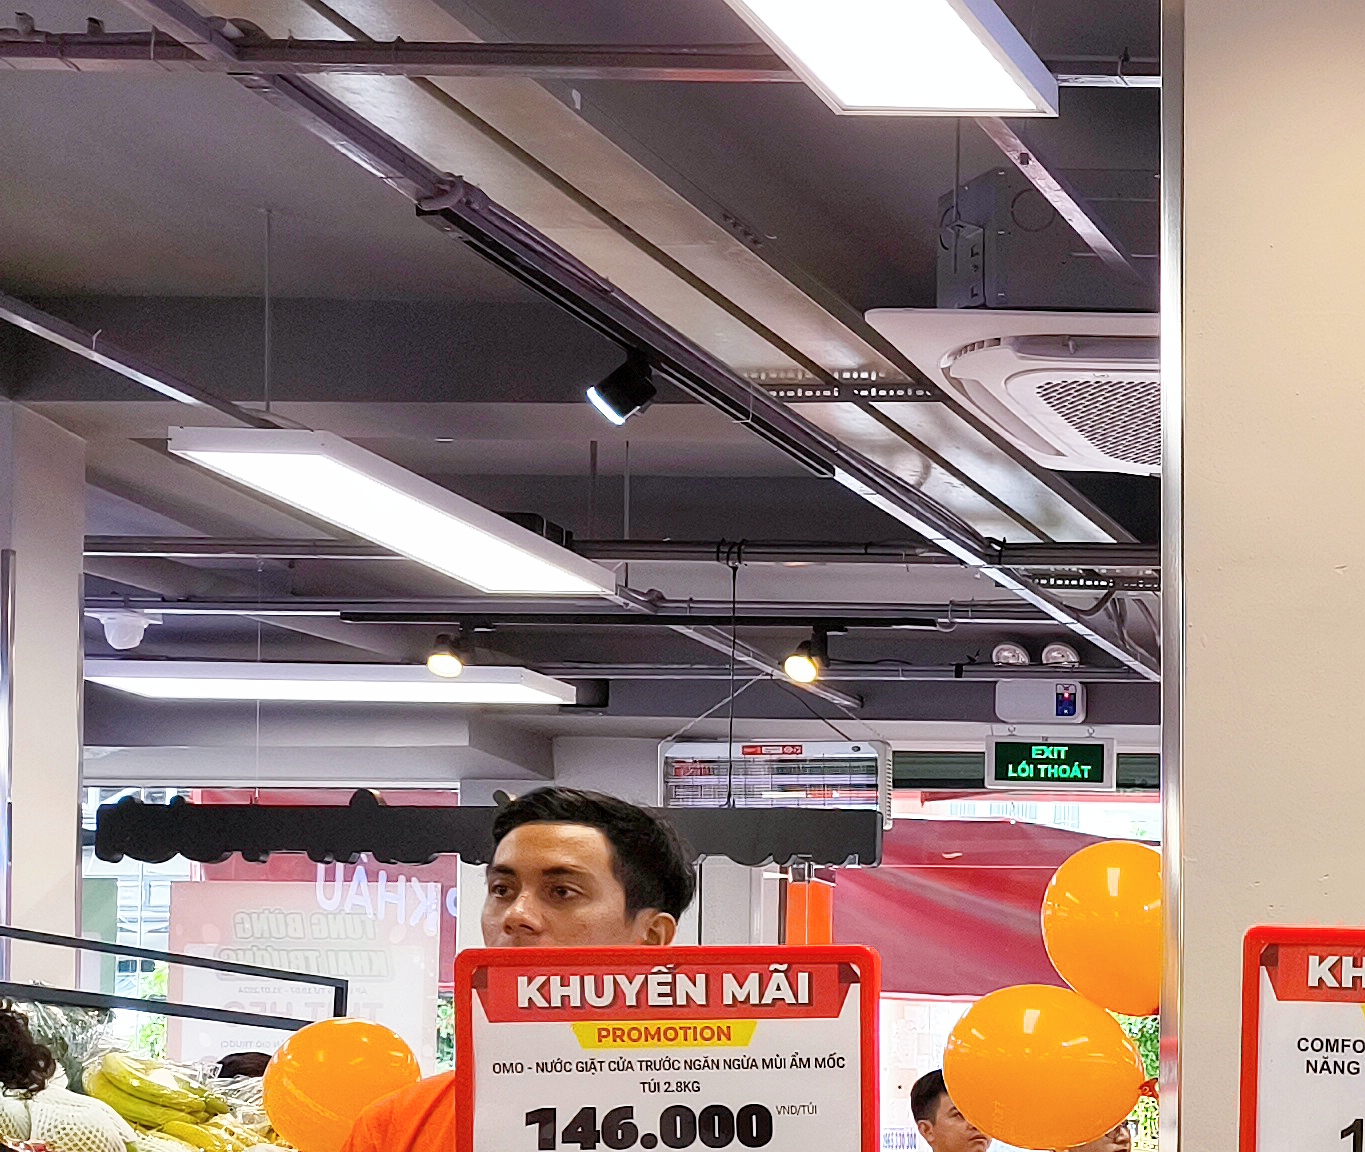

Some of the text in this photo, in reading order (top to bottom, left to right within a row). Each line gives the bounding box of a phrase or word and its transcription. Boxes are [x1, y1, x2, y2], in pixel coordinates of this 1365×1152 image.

[1032, 745, 1068, 761] EXIT
[1037, 761, 1092, 779] THOÁT
[517, 963, 810, 1008] KHUYẾN MÃI
[597, 1025, 732, 1044] PROMOTION
[492, 1062, 523, 1075] OMO
[535, 1056, 572, 1074] NƯỚC
[575, 1058, 605, 1077] GIẶT
[608, 1055, 634, 1073] CỬA
[638, 1055, 681, 1072] TRƯỚC
[684, 1055, 720, 1072] NGĂN
[723, 1055, 758, 1071] NGỪA
[761, 1055, 787, 1071] MÙI
[814, 1052, 846, 1069] MỐC
[1305, 1058, 1360, 1077] NĂNG
[639, 1078, 700, 1094] TÚI 2.8KG
[525, 1103, 773, 1151] 146.000
